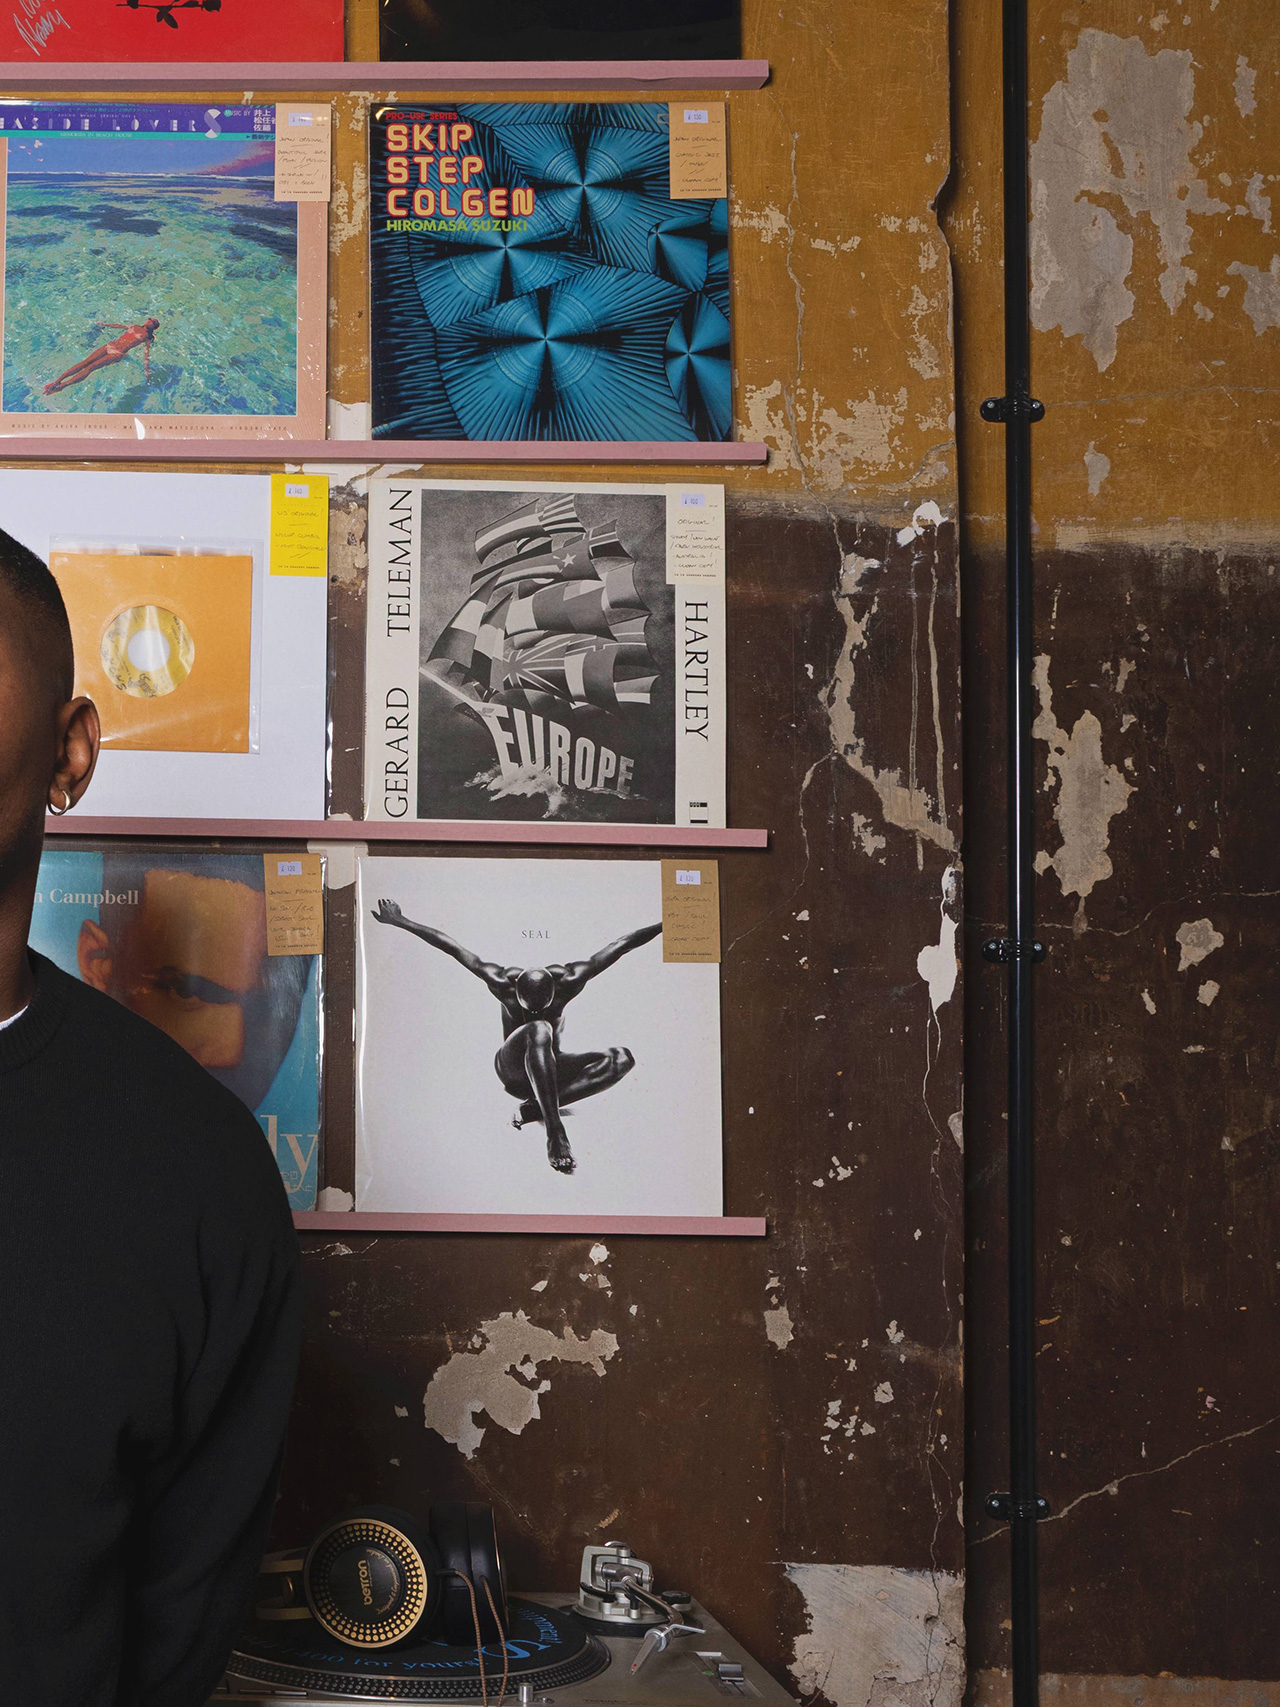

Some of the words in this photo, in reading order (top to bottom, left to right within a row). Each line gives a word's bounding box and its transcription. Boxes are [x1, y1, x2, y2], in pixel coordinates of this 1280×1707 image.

[112, 109, 222, 139] LOVERS
[385, 112, 425, 120] PRO-USE
[429, 112, 458, 120] SERIES
[386, 122, 474, 152] SKIP
[386, 155, 484, 184] STEP
[386, 187, 535, 218] COLGEN
[386, 219, 468, 232] HIROMASA
[471, 219, 528, 232] SUZUKI
[387, 488, 413, 638] TELEMAN
[684, 601, 709, 743] HARTLEY
[384, 687, 410, 819] GERARD
[491, 702, 635, 796] EUROPE
[49, 888, 139, 908] Campbell
[521, 930, 551, 939] SEAL
[358, 1560, 373, 1606] betron
[354, 1657, 392, 1668] for
